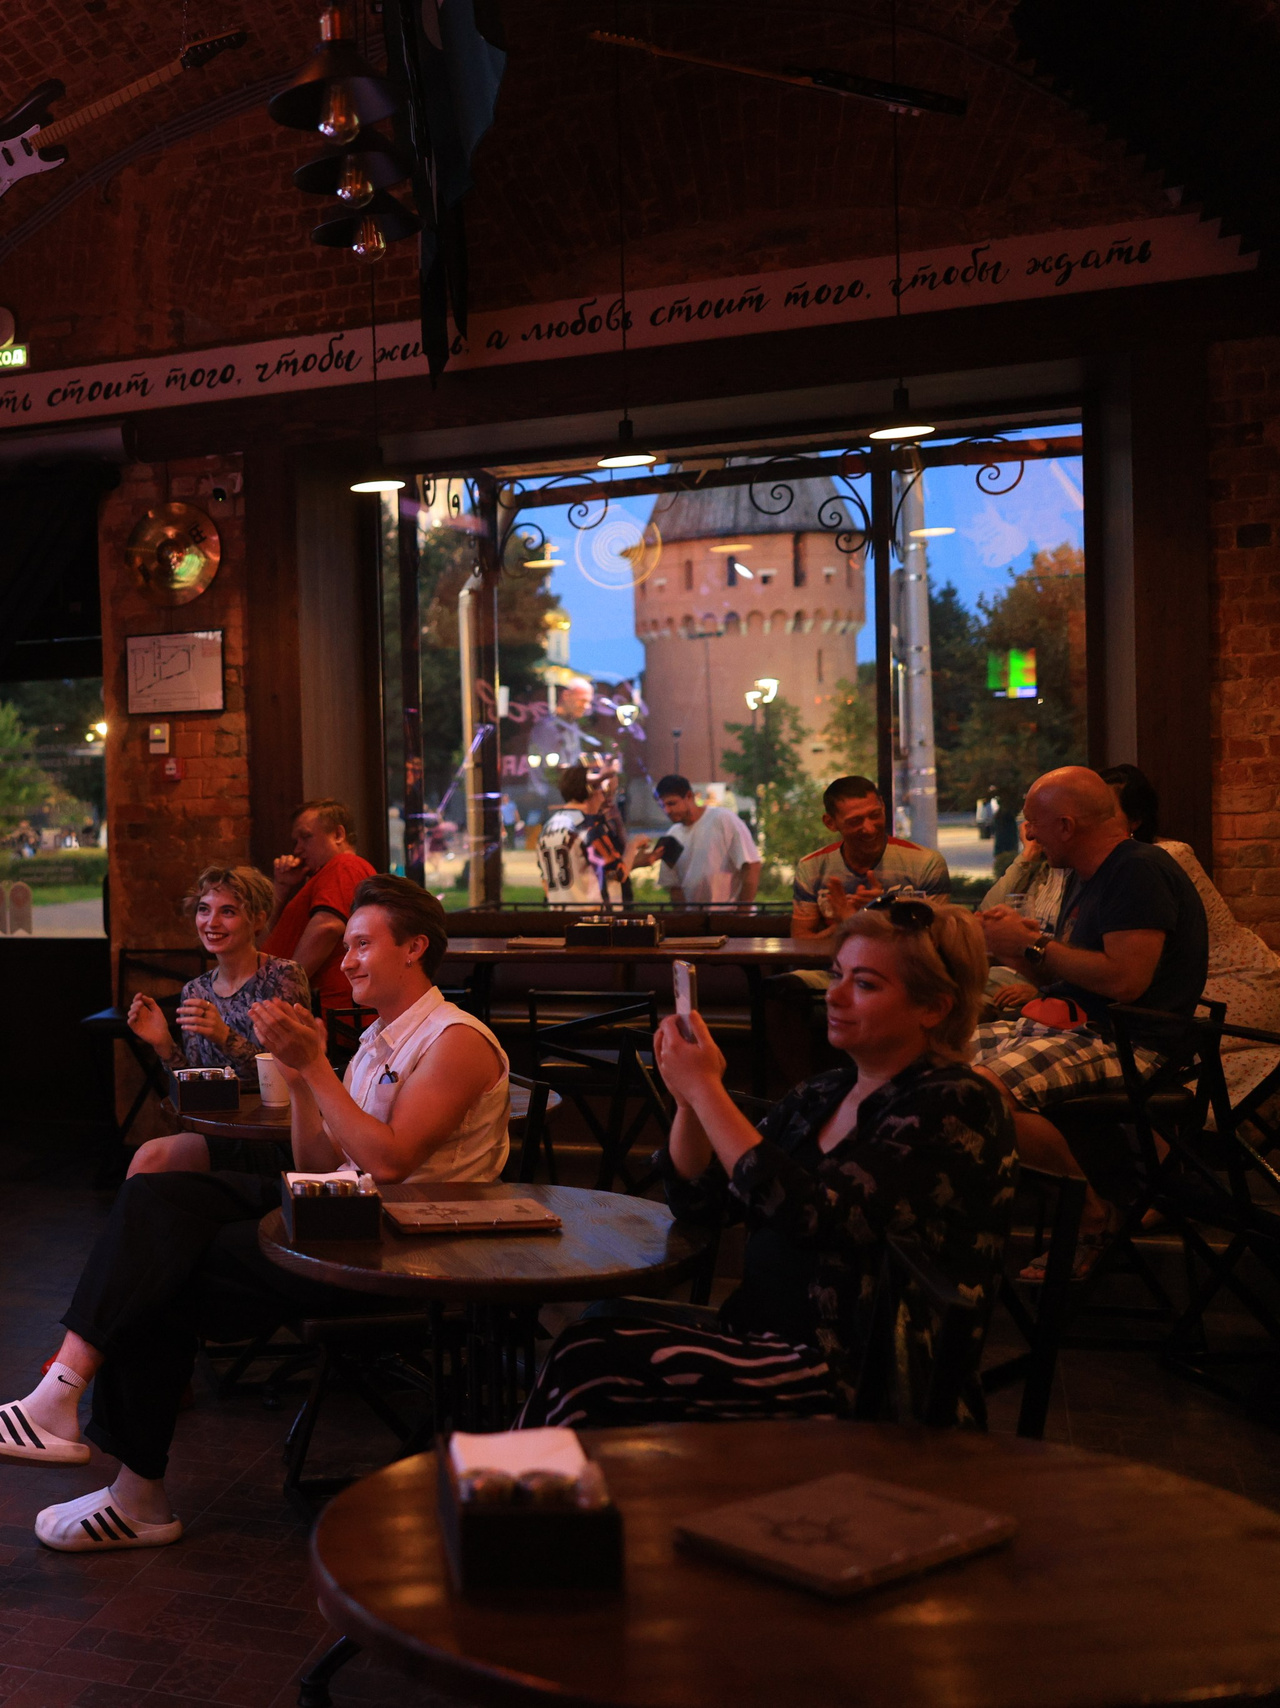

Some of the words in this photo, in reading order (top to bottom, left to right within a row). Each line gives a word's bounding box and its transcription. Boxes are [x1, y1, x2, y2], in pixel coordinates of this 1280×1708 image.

[47, 371, 155, 407] стоит
[165, 364, 242, 391] того,
[256, 333, 363, 383] чтобы
[375, 334, 470, 365] жиь,
[486, 329, 510, 350] а
[521, 298, 633, 342] любовь
[650, 286, 771, 327] стоит
[889, 244, 1010, 297] чтобы
[1026, 237, 1152, 287] ждать
[540, 845, 573, 891] 13
